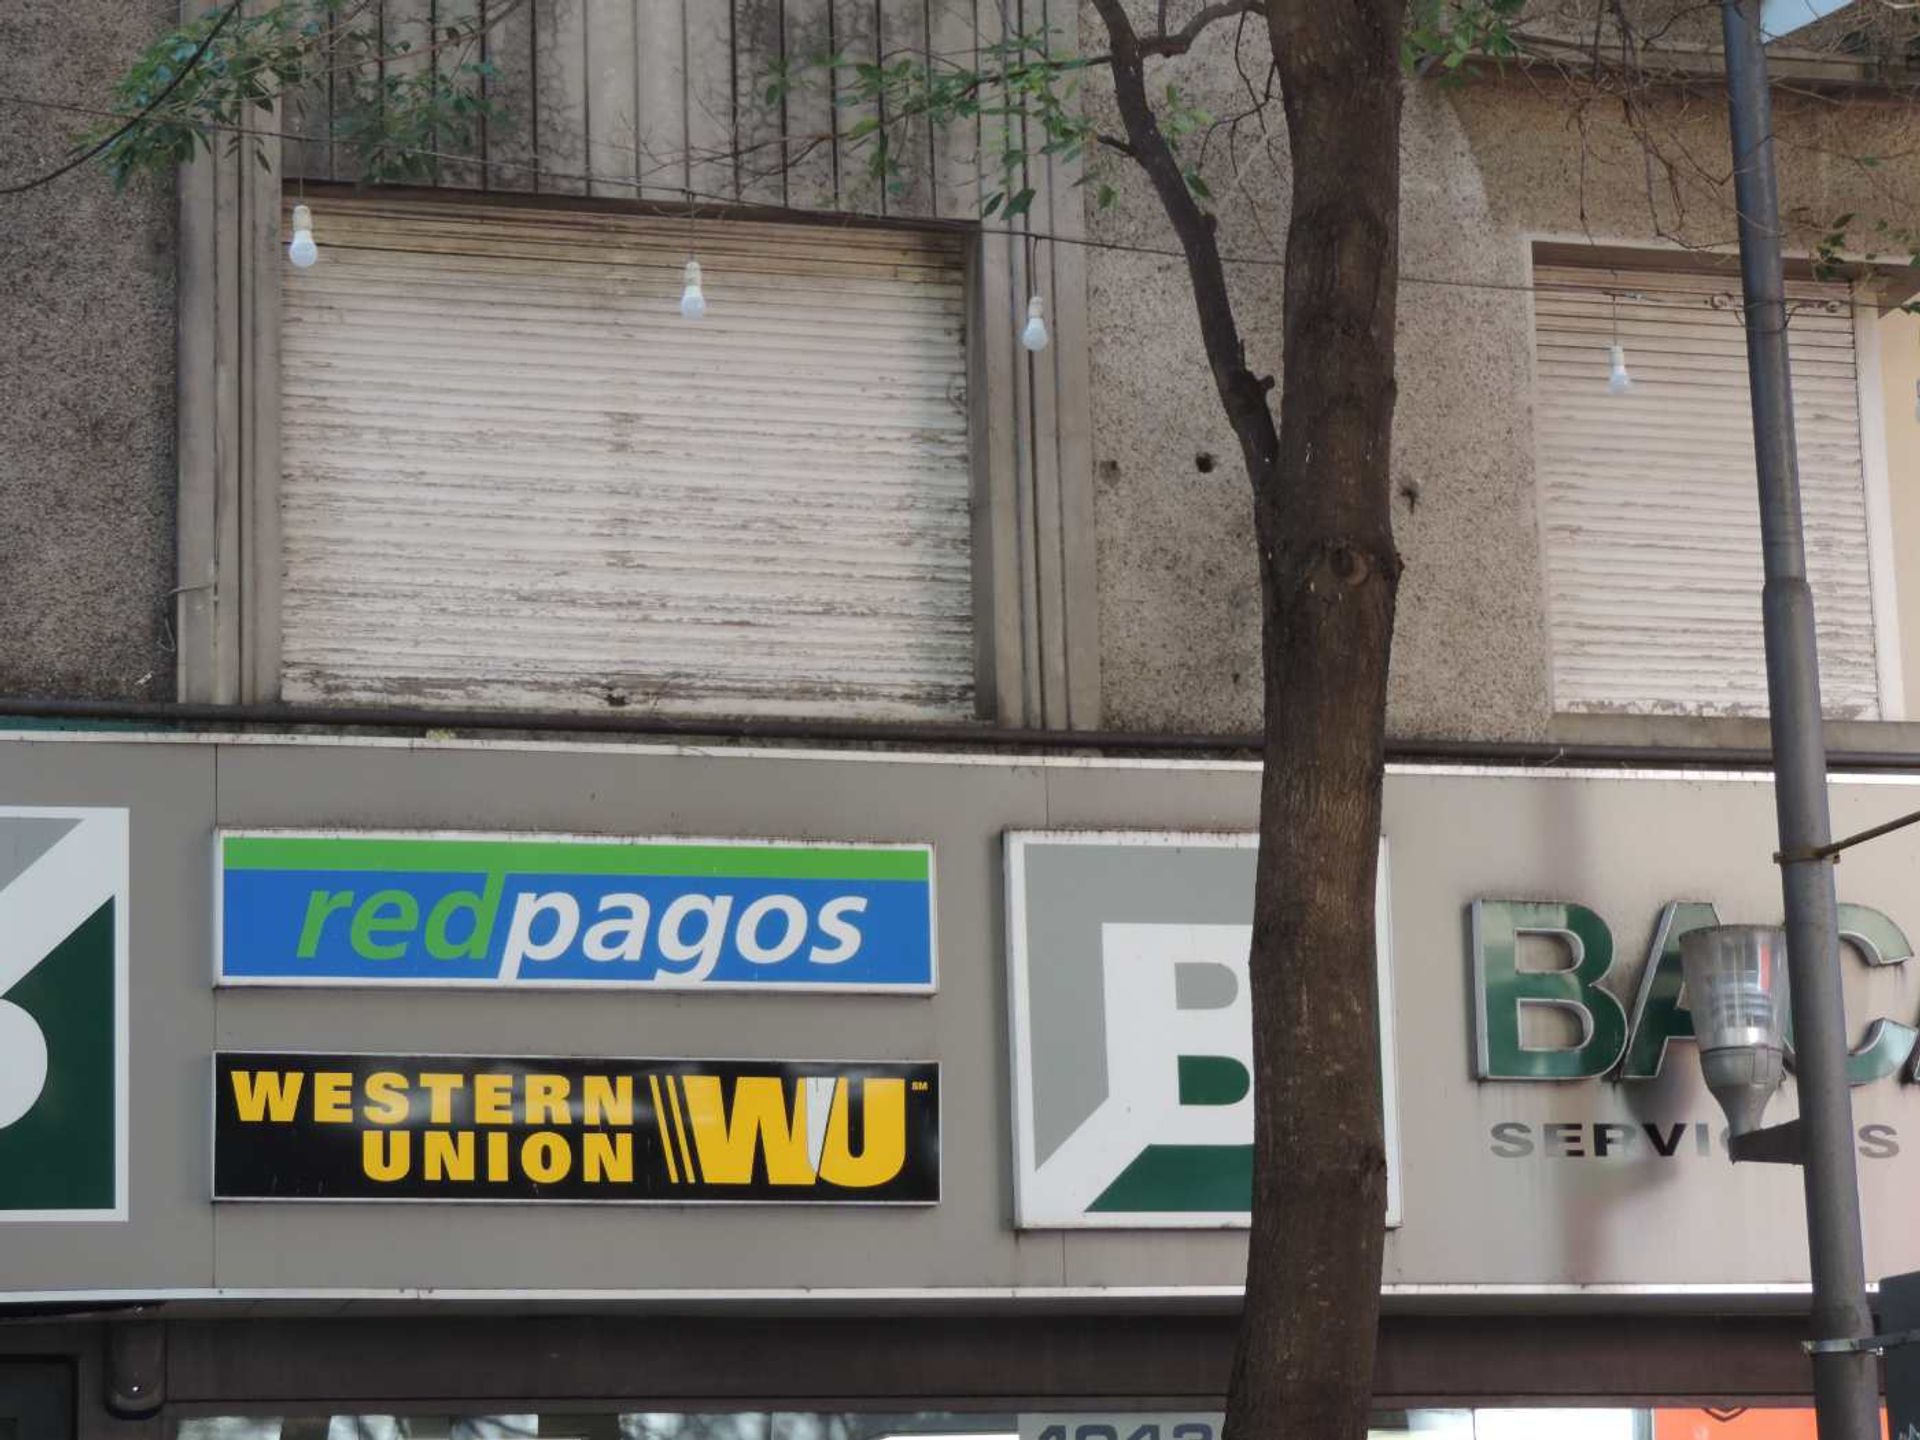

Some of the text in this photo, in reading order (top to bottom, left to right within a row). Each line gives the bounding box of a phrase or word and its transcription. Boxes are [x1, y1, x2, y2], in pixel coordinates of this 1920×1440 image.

[296, 871, 867, 981] redpagos
[1471, 900, 1920, 1088] BAC
[231, 1071, 633, 1125] WESTERN
[684, 1076, 906, 1188] WU
[362, 1131, 633, 1184] UNION
[1490, 1122, 1900, 1158] SERVIS
